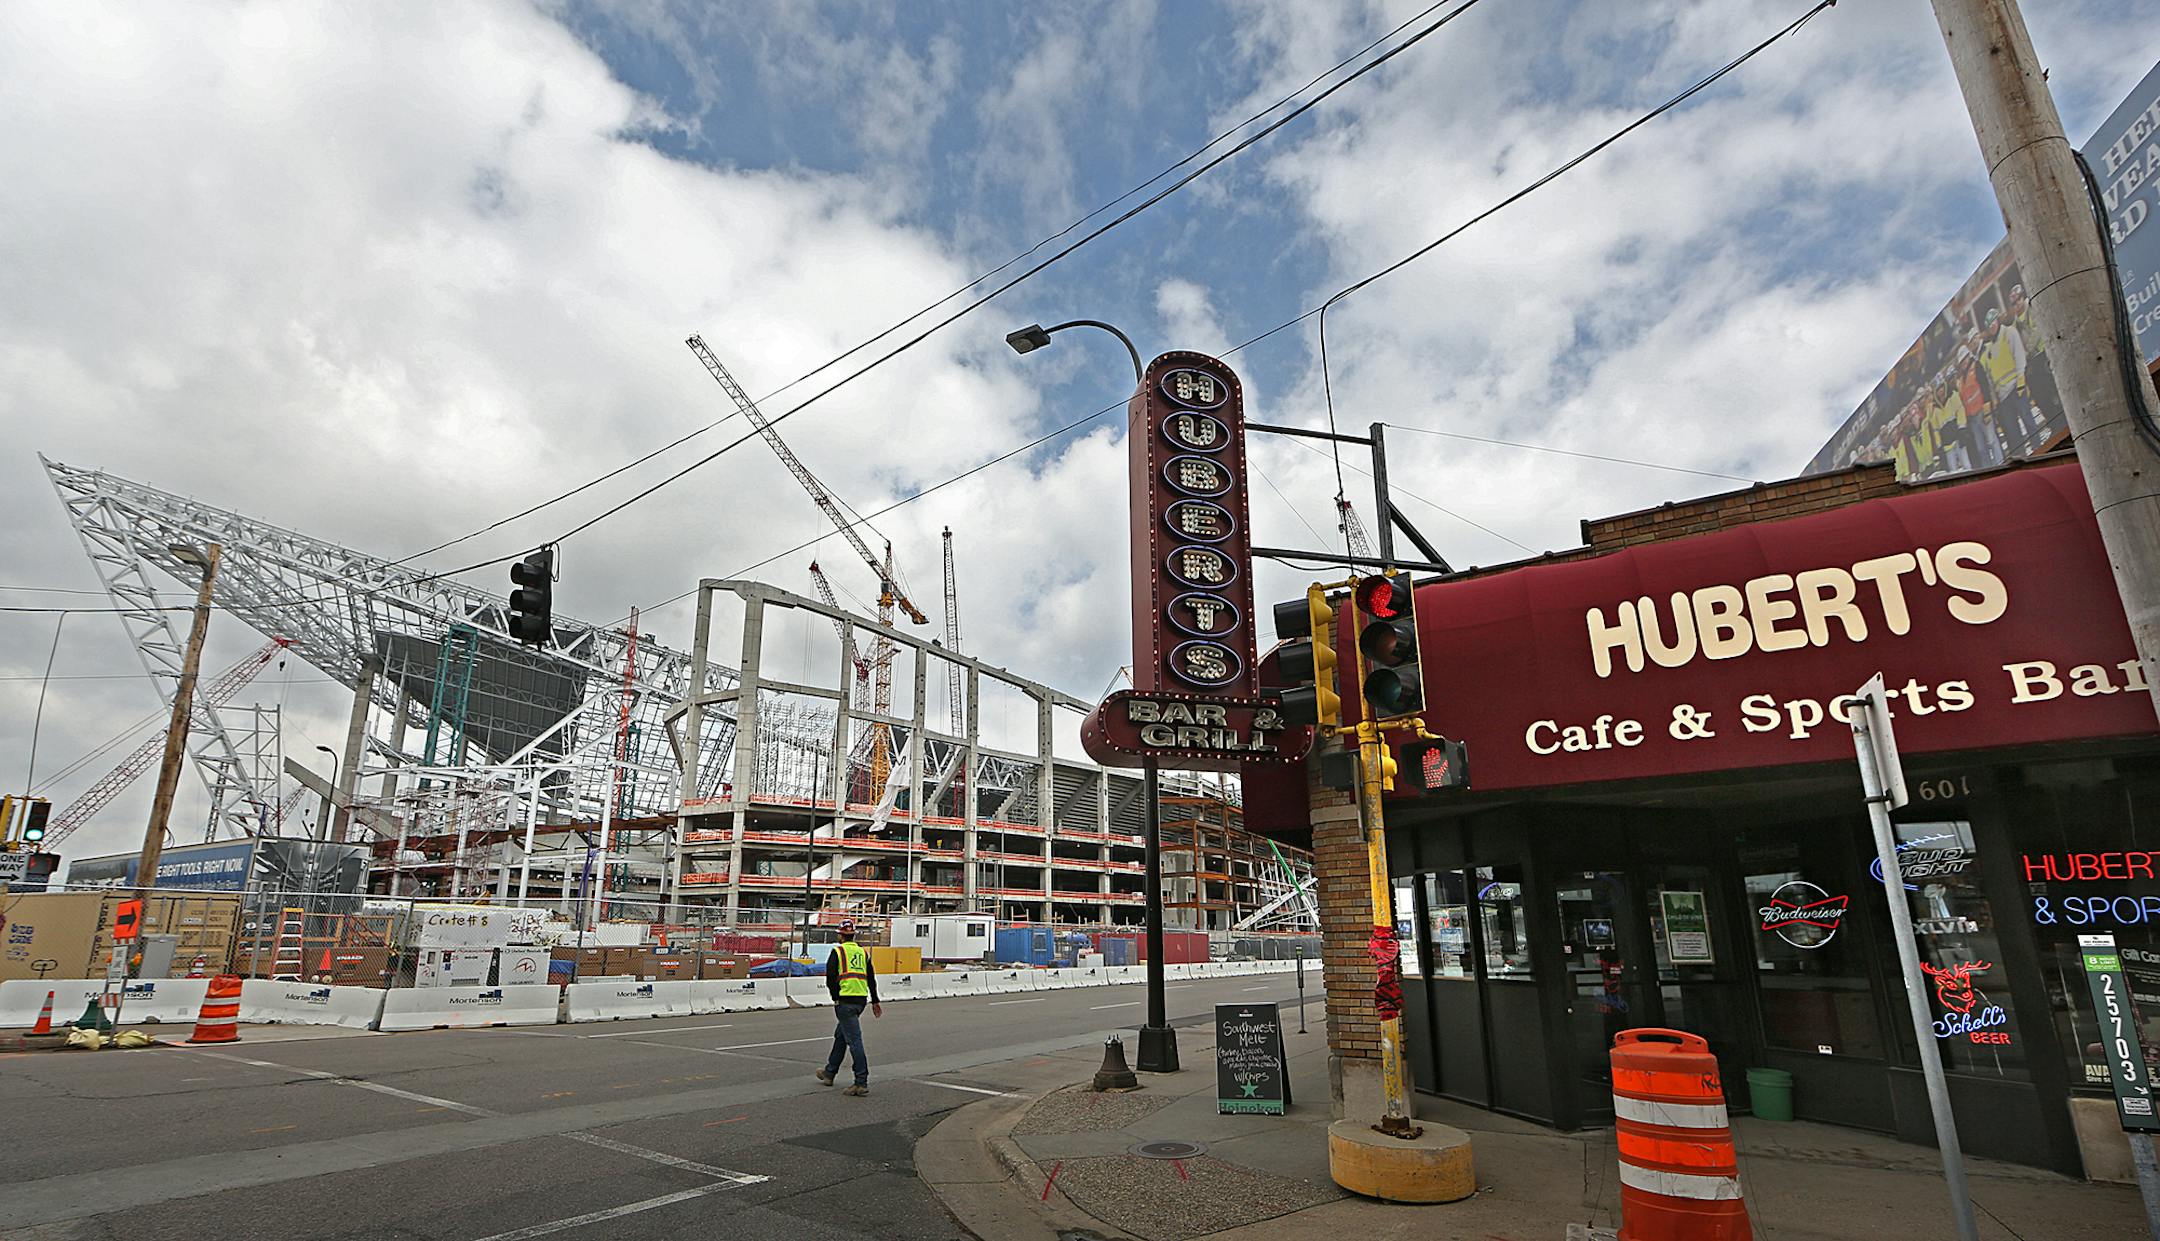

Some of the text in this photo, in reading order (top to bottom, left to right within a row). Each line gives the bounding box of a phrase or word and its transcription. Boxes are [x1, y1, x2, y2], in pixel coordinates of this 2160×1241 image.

[1586, 541, 2009, 678] HUBERT'S
[1128, 699, 1286, 730] BAR &
[1525, 659, 2149, 755] Cafe & Spots Bar
[1140, 723, 1279, 752] GRILL
[1919, 776, 1970, 801] 601
[0, 854, 25, 863] ONE
[0, 863, 25, 871] WAY
[203, 859, 225, 874] RIGHT
[1899, 857, 1973, 878] IGHT
[1758, 906, 1848, 923] Budweiser
[2034, 896, 2058, 925] &
[284, 993, 328, 1002] Mortenson
[1222, 1020, 1276, 1037] Southwest
[1239, 1032, 1268, 1047] Melt
[1969, 1031, 2012, 1045] BEER
[1219, 1102, 1281, 1114] Heineken
